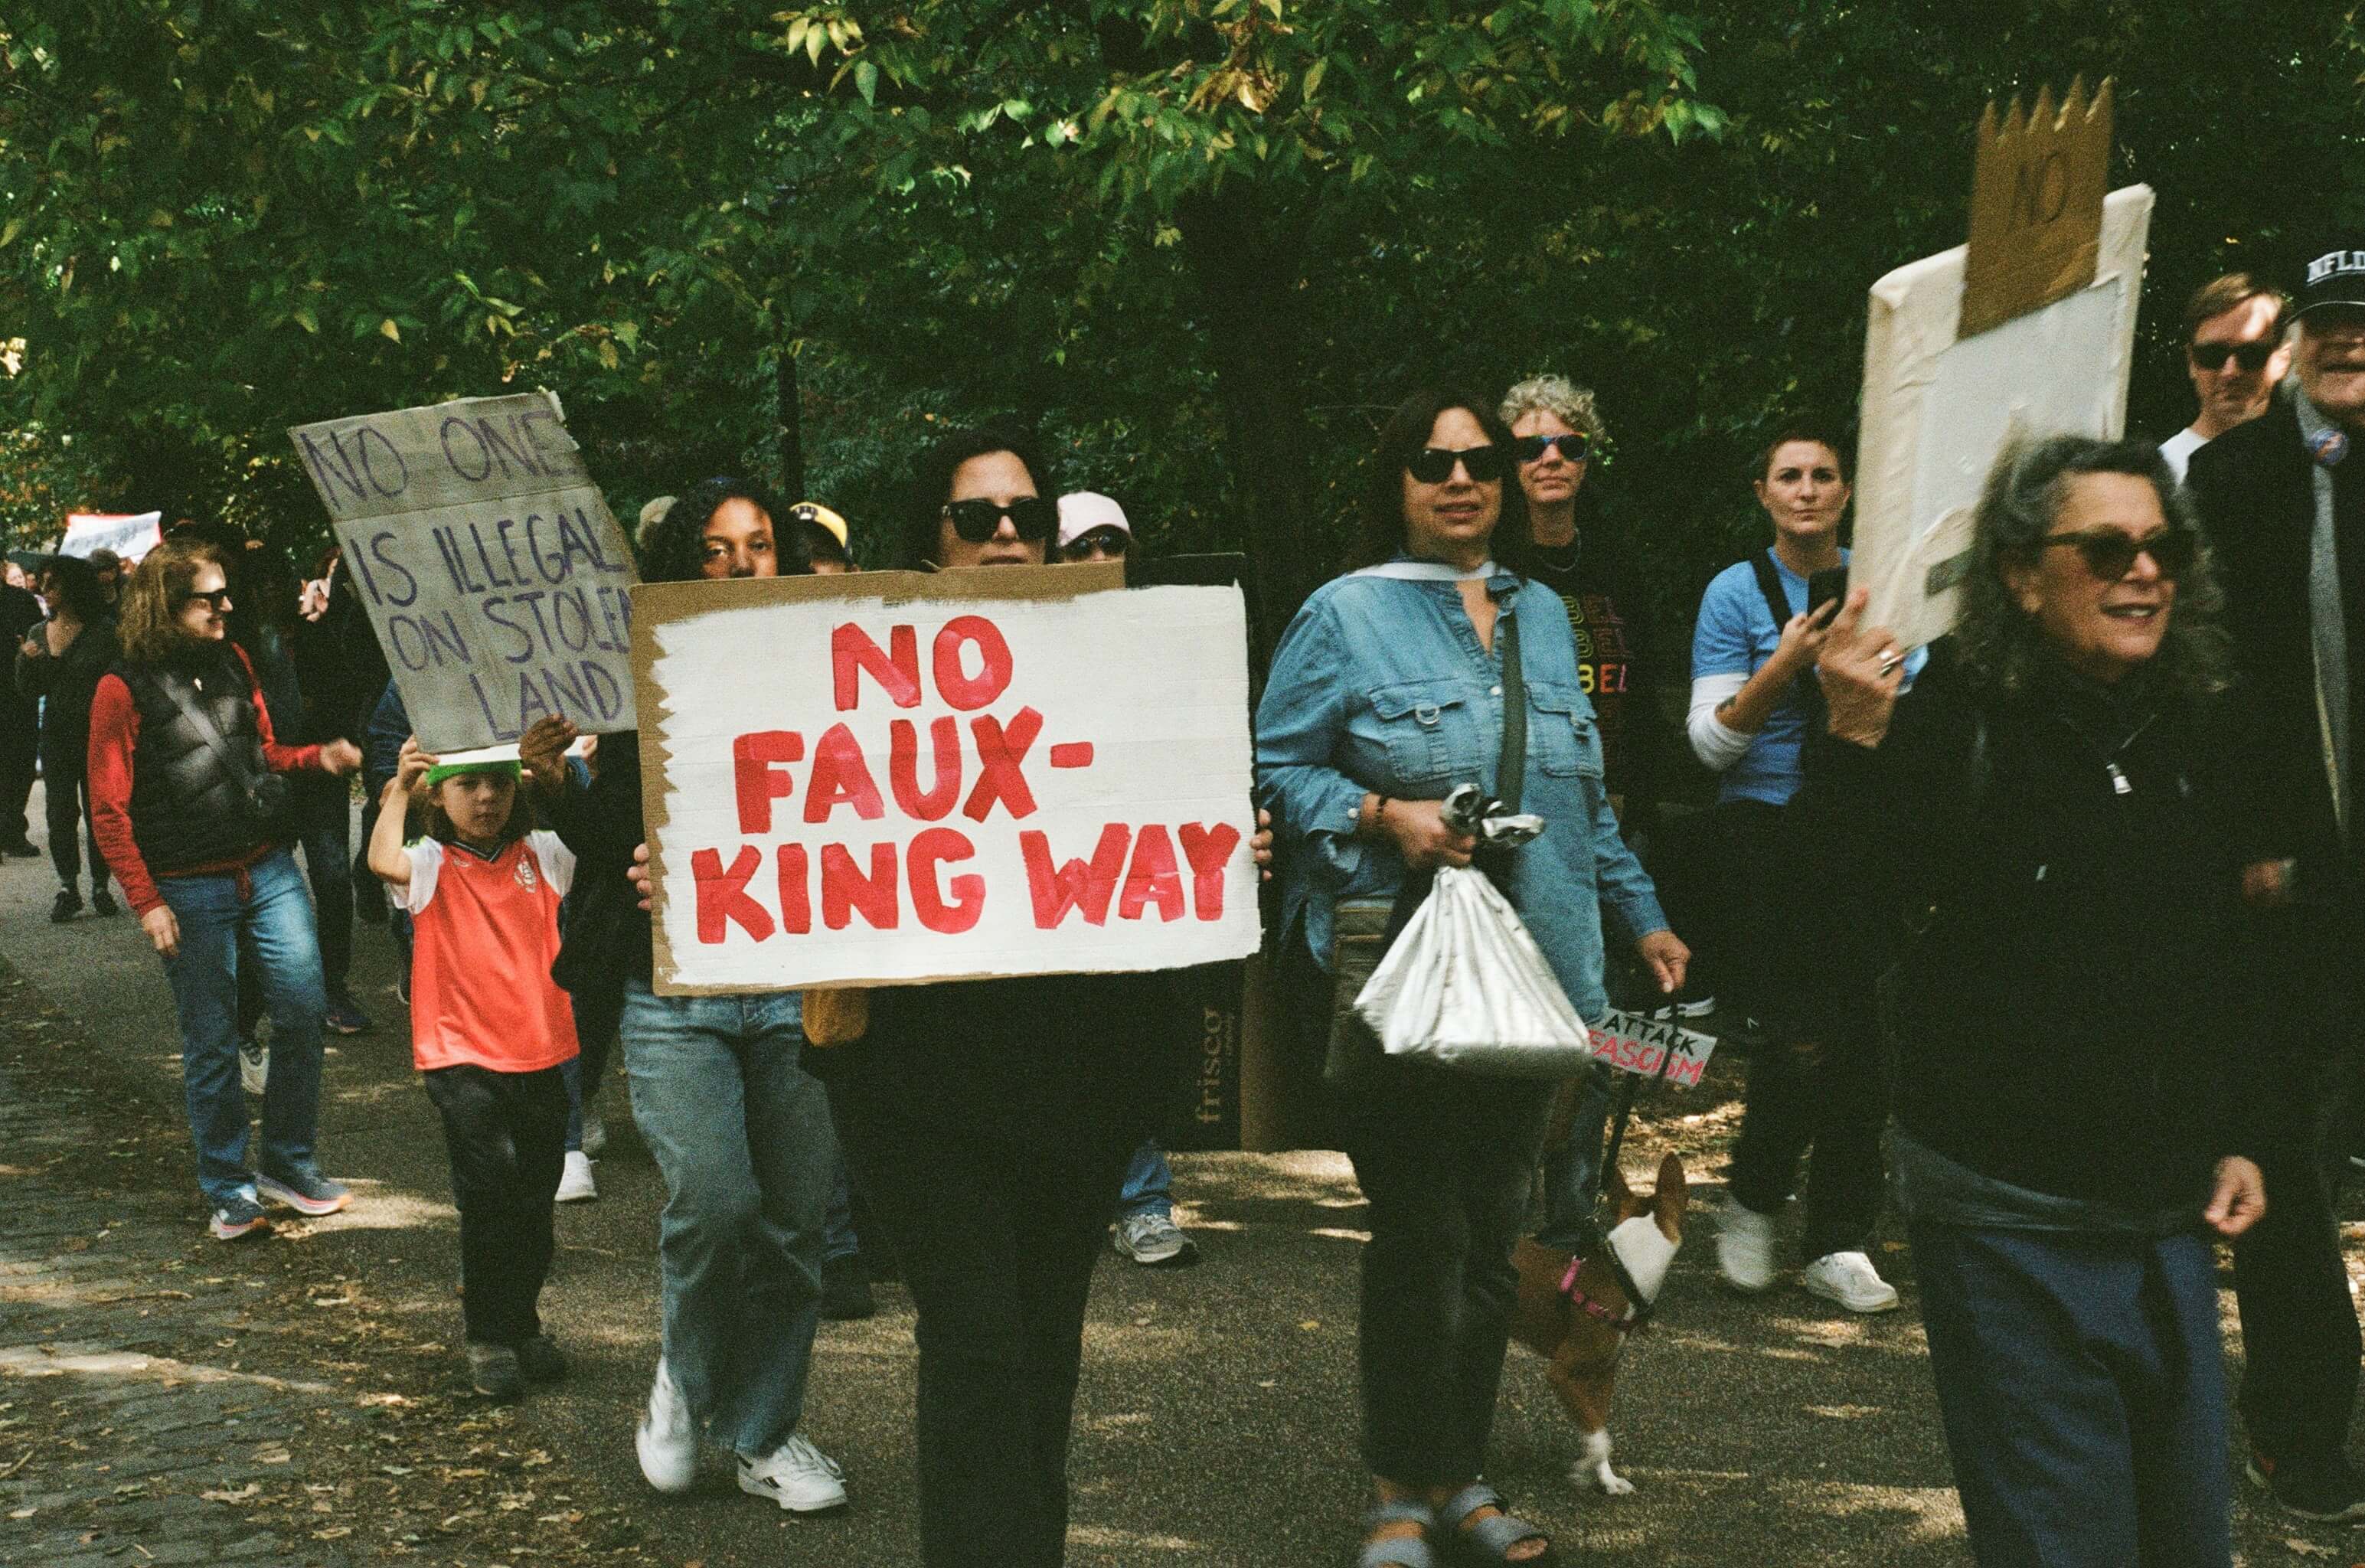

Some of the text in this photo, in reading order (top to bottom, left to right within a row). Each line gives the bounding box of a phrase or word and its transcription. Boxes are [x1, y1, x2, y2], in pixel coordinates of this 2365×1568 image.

[299, 410, 577, 511] NO ONE
[350, 508, 626, 607] IS ILLEGAL
[389, 610, 473, 671] ON
[831, 614, 1014, 712] NO
[469, 659, 623, 742] LAND
[733, 705, 1094, 835] FAUX-
[691, 822, 1241, 945] KING WAY
[1602, 1014, 1698, 1057] ATTACK
